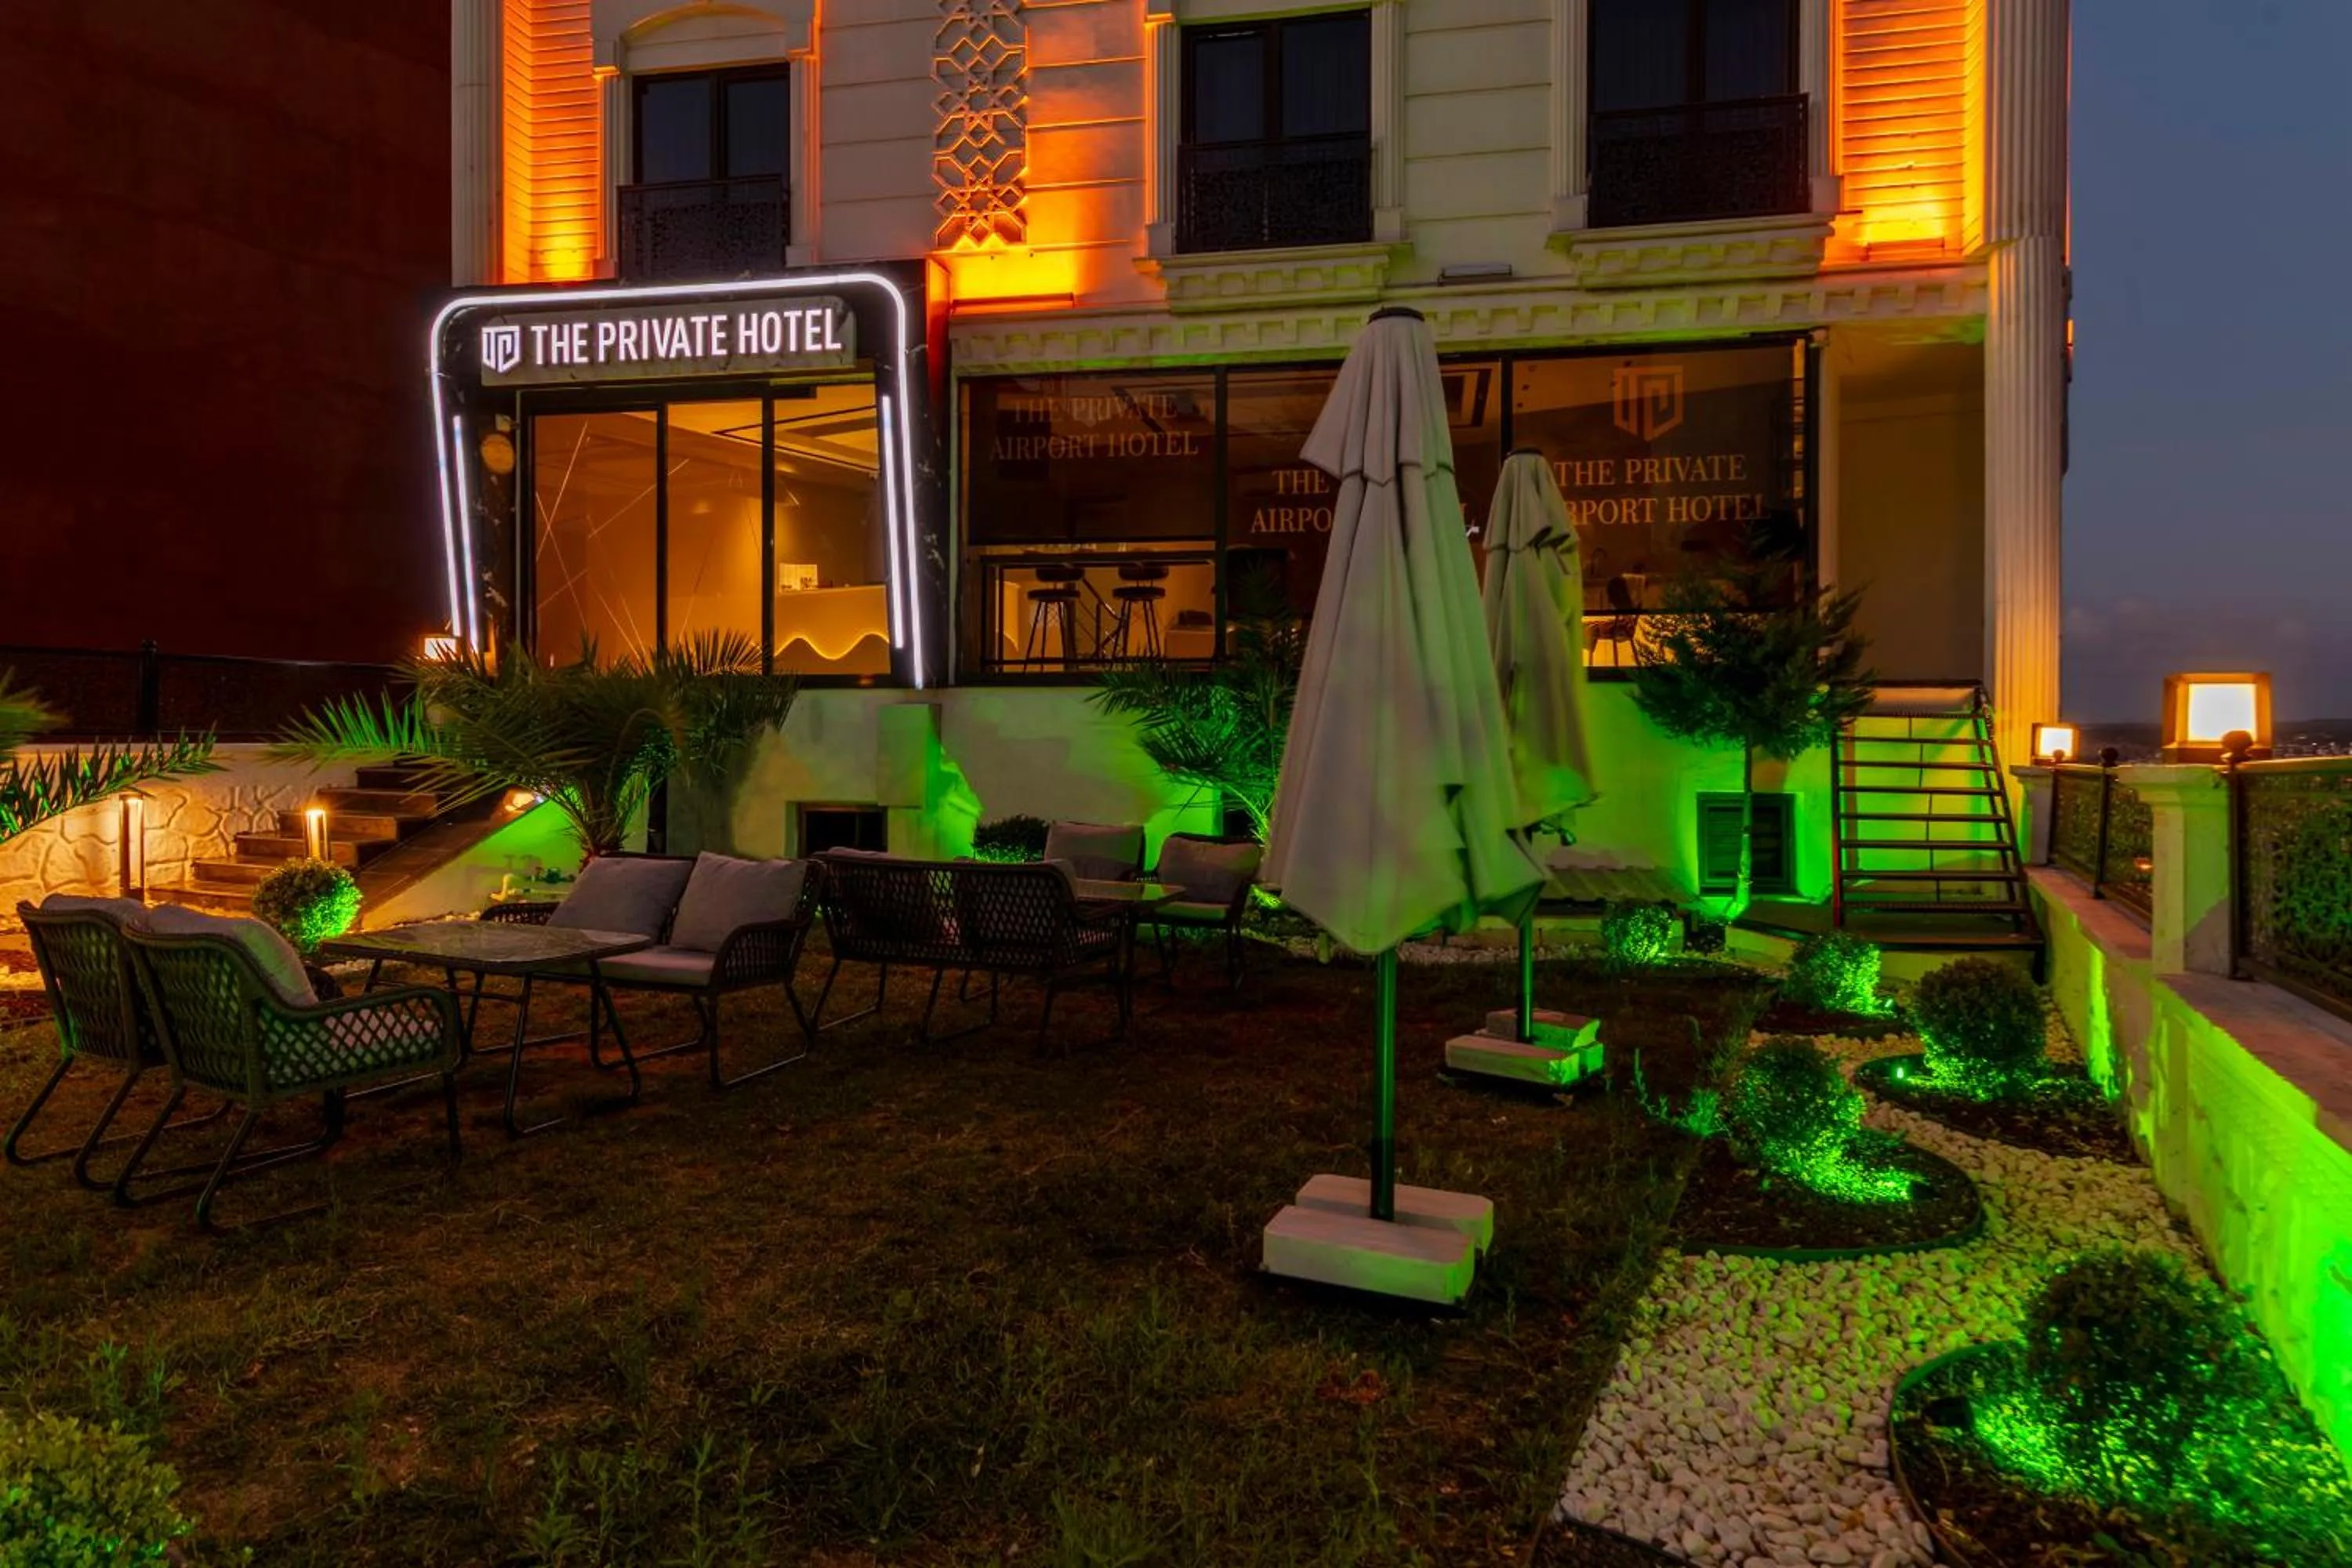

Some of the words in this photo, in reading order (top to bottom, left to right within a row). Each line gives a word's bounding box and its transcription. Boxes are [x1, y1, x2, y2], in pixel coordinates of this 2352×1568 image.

[530, 322, 590, 365] THE
[597, 314, 728, 363] PRIVATE
[739, 308, 841, 354] HOTEL
[1009, 398, 1060, 424] THE
[989, 434, 1099, 463] AIRPORT
[1107, 430, 1200, 458] HOTEL
[1271, 469, 1330, 495] THE
[1552, 459, 1617, 488] THE
[1623, 454, 1748, 485] PRIVATE
[1250, 506, 1333, 534] AIRPO
[1666, 493, 1771, 523] HOTEL
